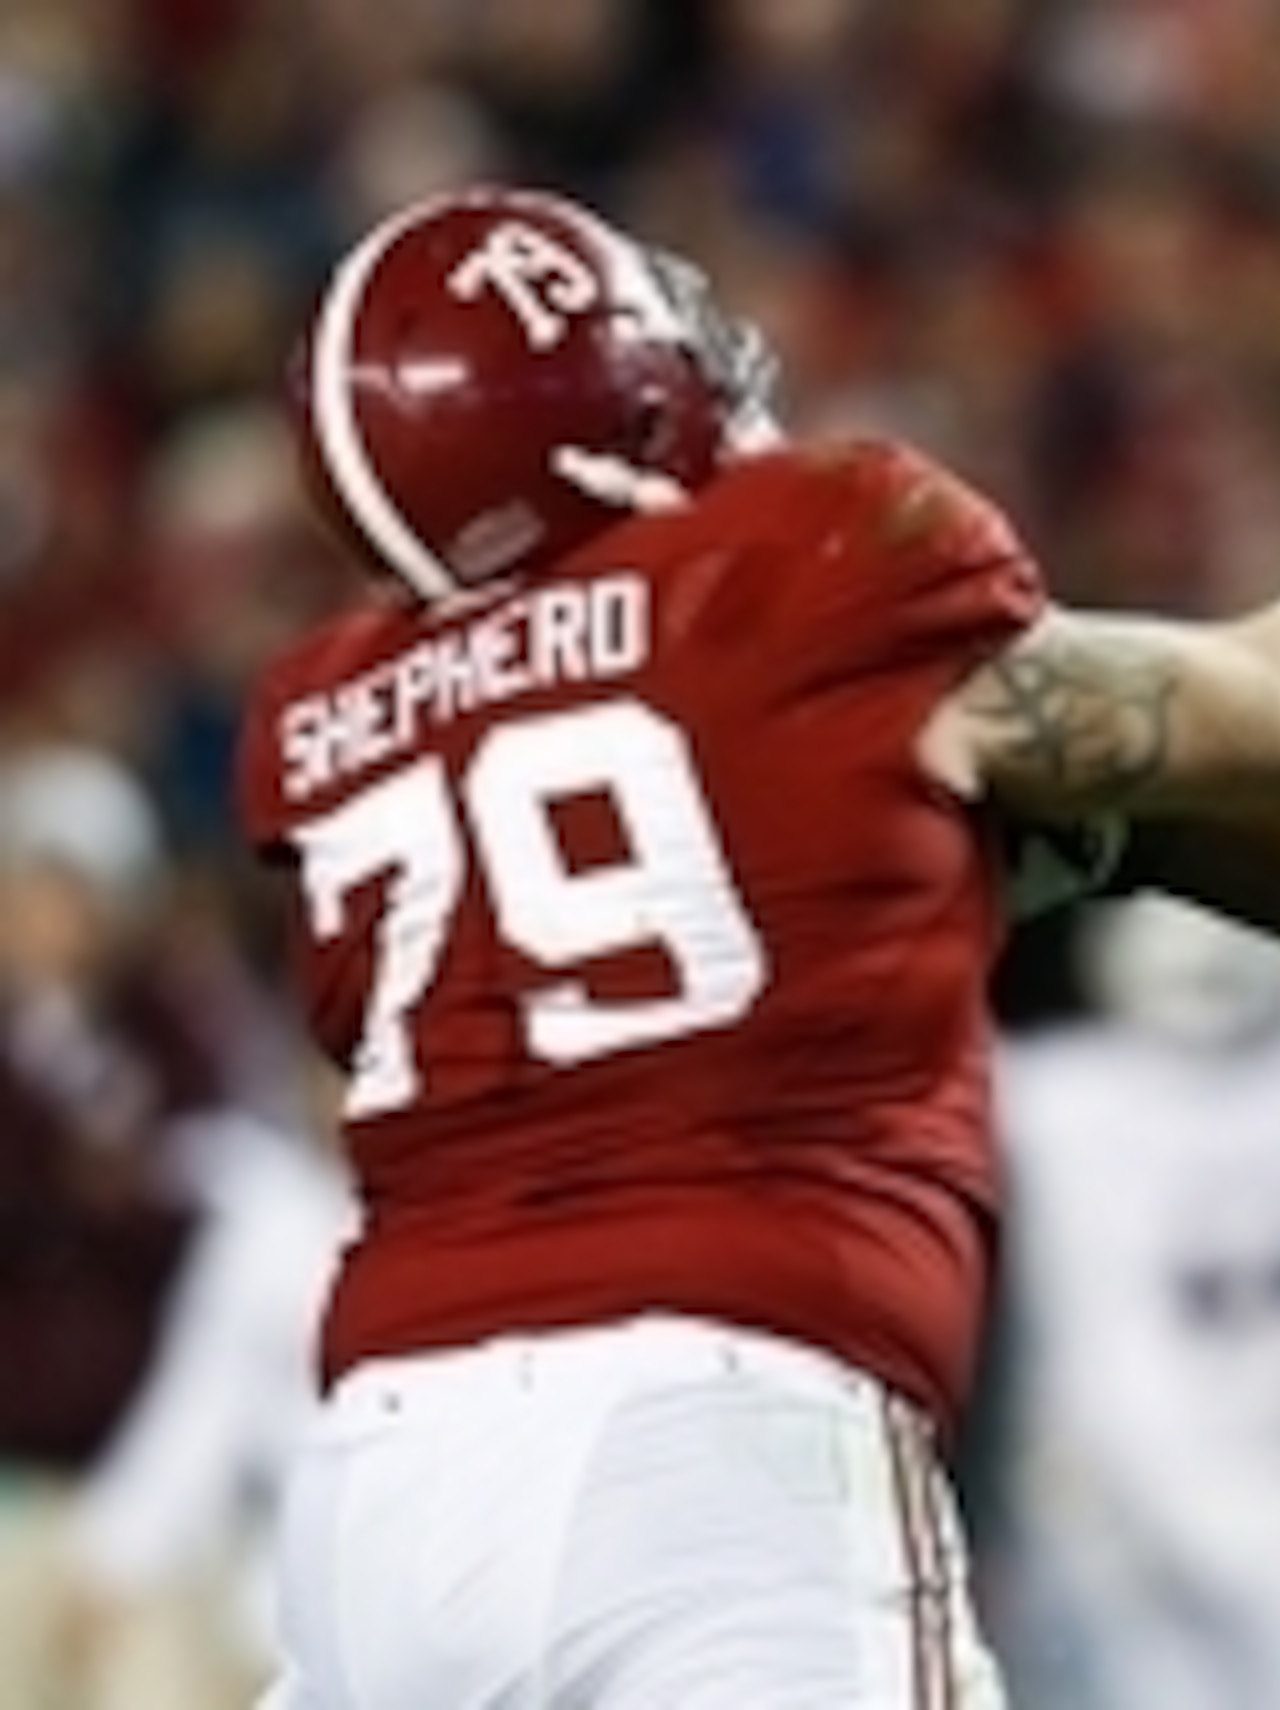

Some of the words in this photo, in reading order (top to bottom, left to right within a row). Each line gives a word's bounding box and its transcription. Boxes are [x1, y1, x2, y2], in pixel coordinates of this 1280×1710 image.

[448, 221, 597, 347] 79
[280, 572, 649, 799] SHEPHERD
[292, 698, 766, 1118] 79
